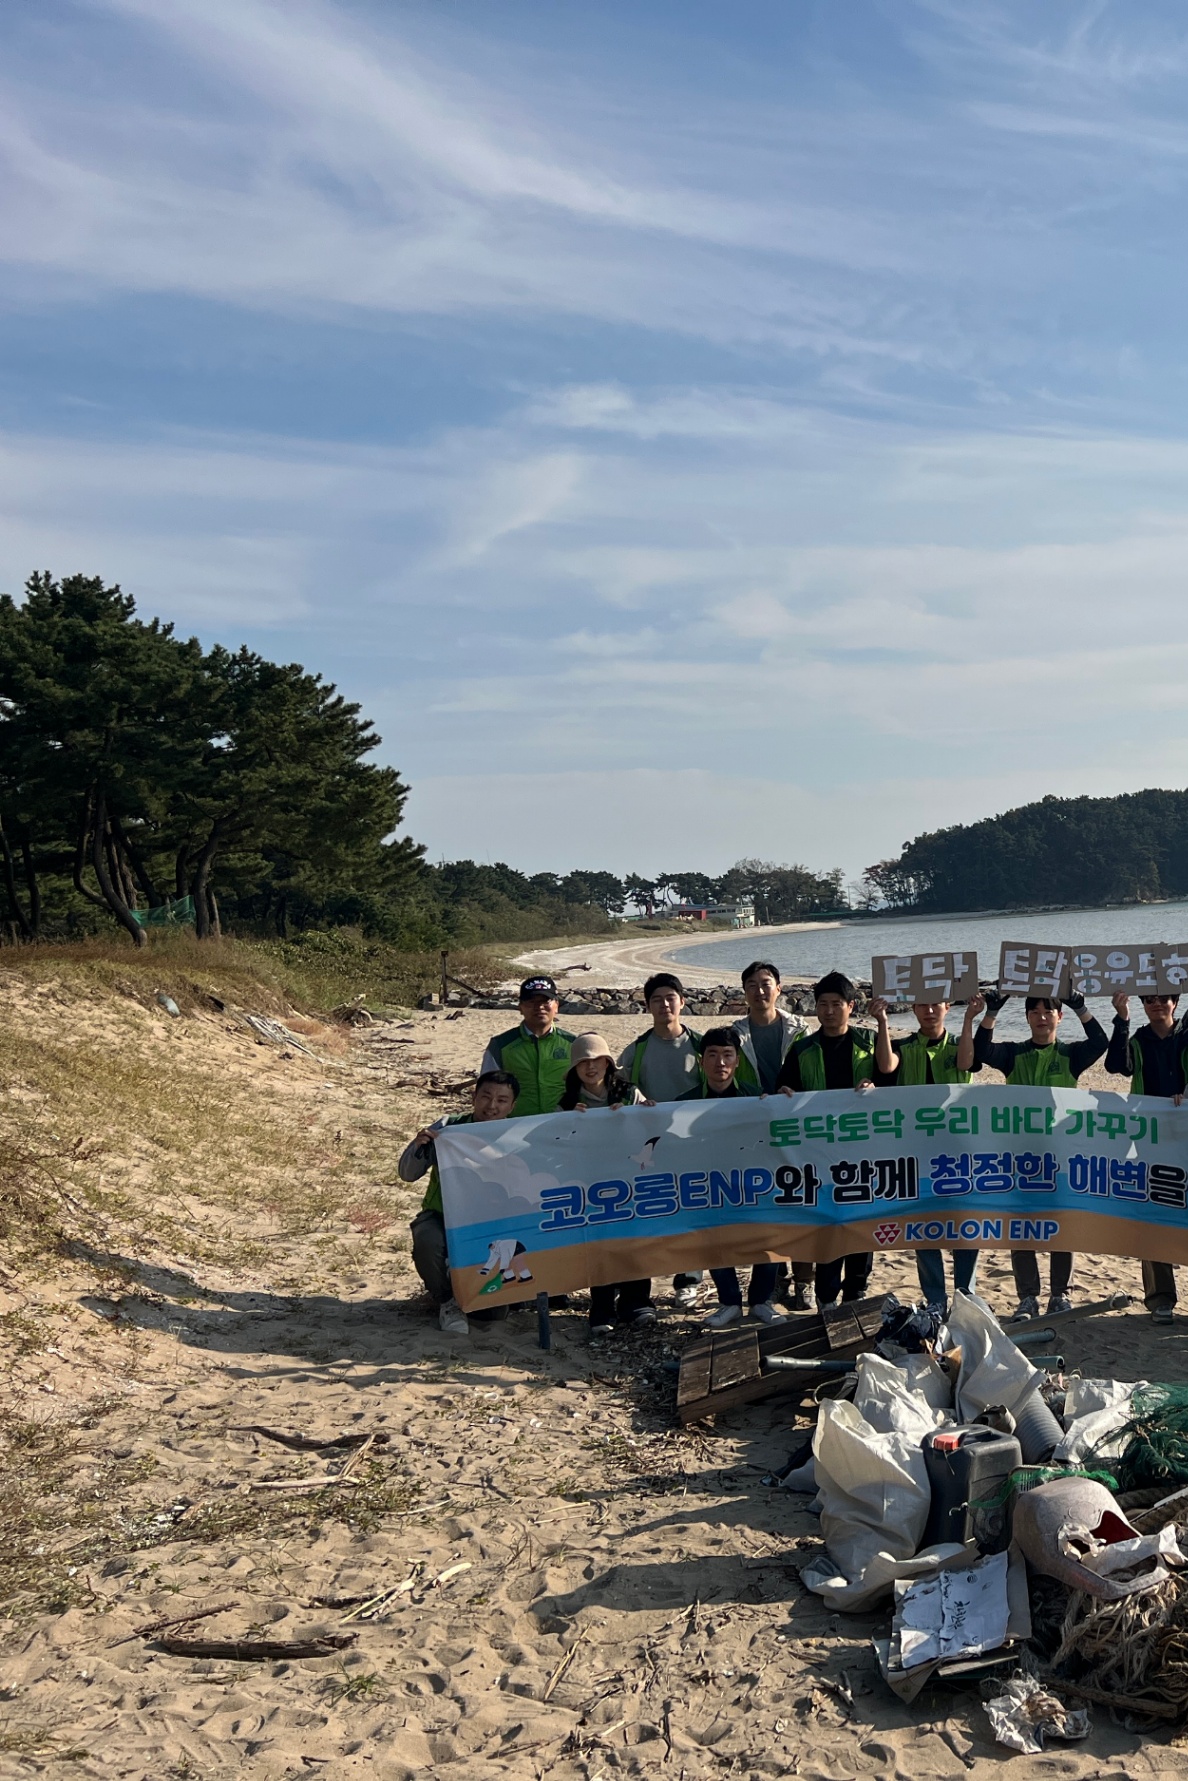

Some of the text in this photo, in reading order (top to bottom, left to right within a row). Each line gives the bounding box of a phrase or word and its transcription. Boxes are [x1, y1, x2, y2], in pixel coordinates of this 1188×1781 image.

[879, 953, 968, 1000] 토닥
[1001, 950, 1067, 997] 토닥
[769, 1105, 1159, 1147] 토닥토닥 우리 바다 가꾸기
[539, 1164, 821, 1232] 코오롱ENP와
[830, 1155, 920, 1203] 함께
[929, 1152, 1059, 1195] 청정한
[1068, 1153, 1188, 1210] 해변을
[905, 1219, 1060, 1242] KOLON ENP
